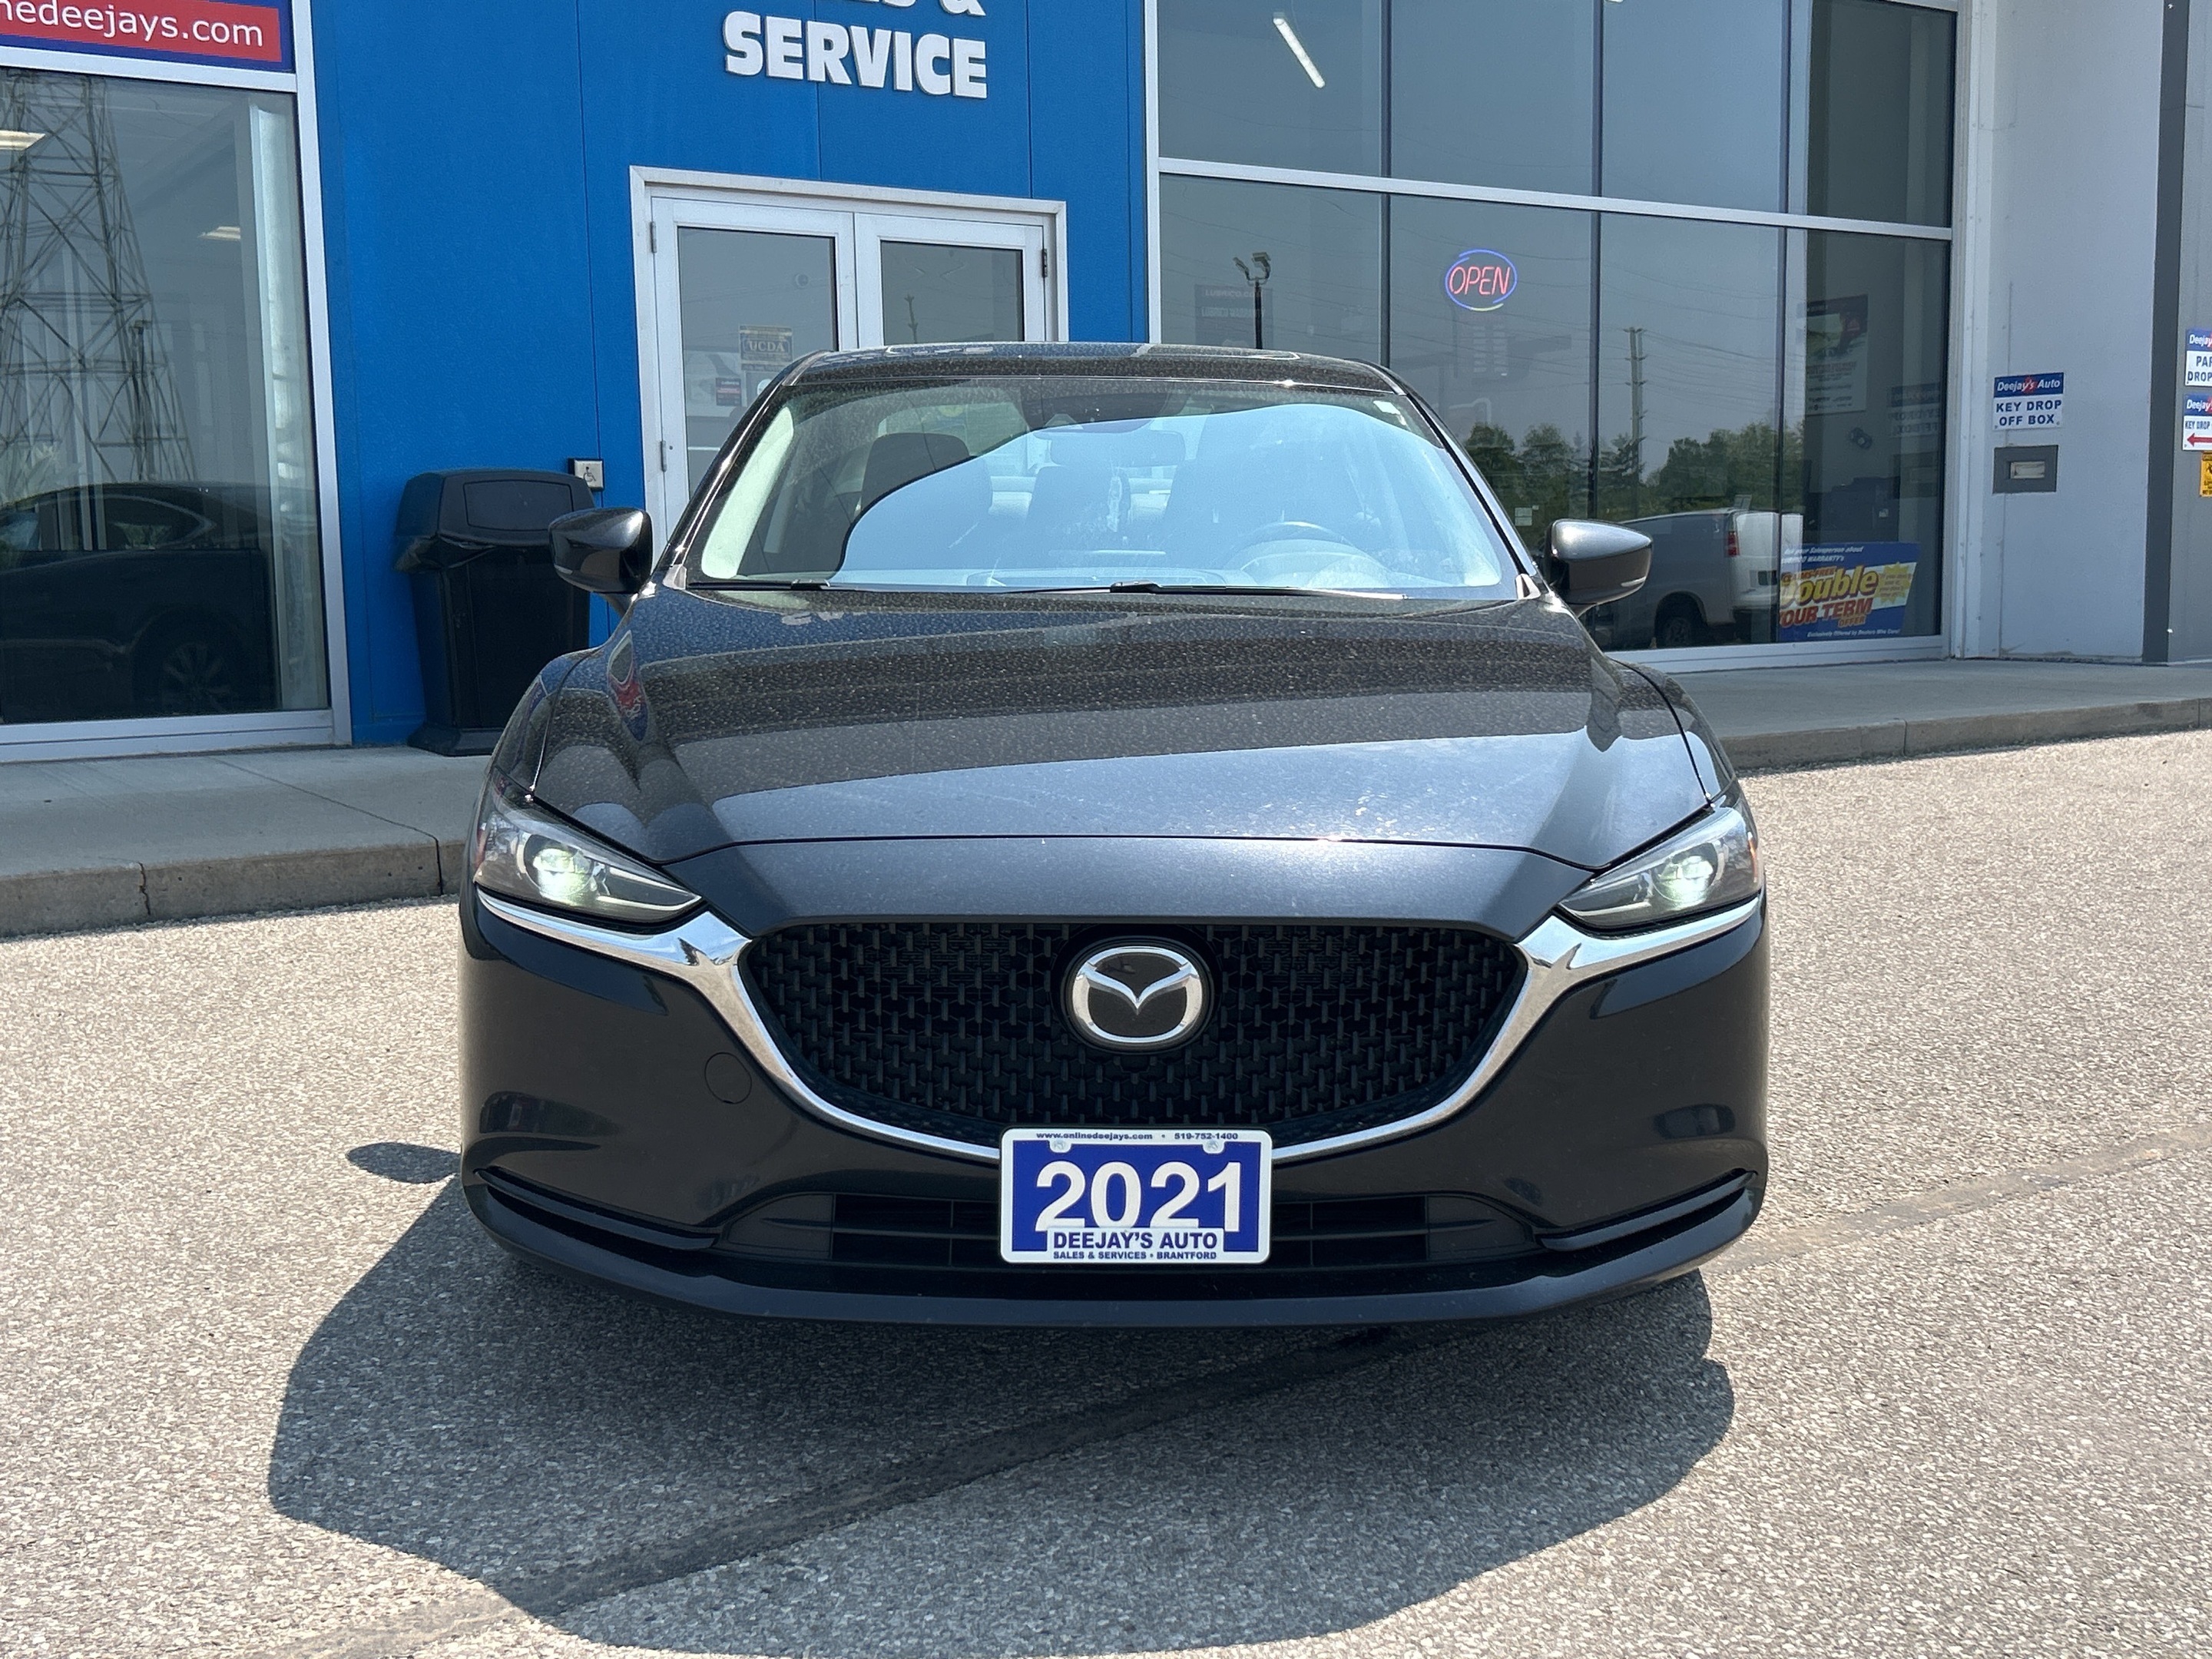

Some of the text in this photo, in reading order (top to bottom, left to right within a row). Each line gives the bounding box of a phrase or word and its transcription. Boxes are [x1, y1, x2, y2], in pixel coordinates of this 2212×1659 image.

[723, 11, 988, 99] SERVICE
[1449, 266, 1511, 295] OPEN
[747, 340, 785, 352] UCDA
[1997, 379, 2061, 392] Deejay's Auto
[1996, 399, 2061, 412] KEY DROP
[1999, 414, 2055, 426] OFF BOX
[2185, 420, 2210, 429] KEY DROP
[1822, 598, 1874, 621] TERM
[1838, 615, 1866, 628] OFFER
[1036, 1132, 1238, 1141] www.onlinedeejays.com 519-752-1400
[1035, 1161, 1241, 1232] 2021
[1053, 1232, 1217, 1249] DEEJAY'S AUTO
[1053, 1251, 1217, 1260] SALES & SERVICES BRANTFORD
